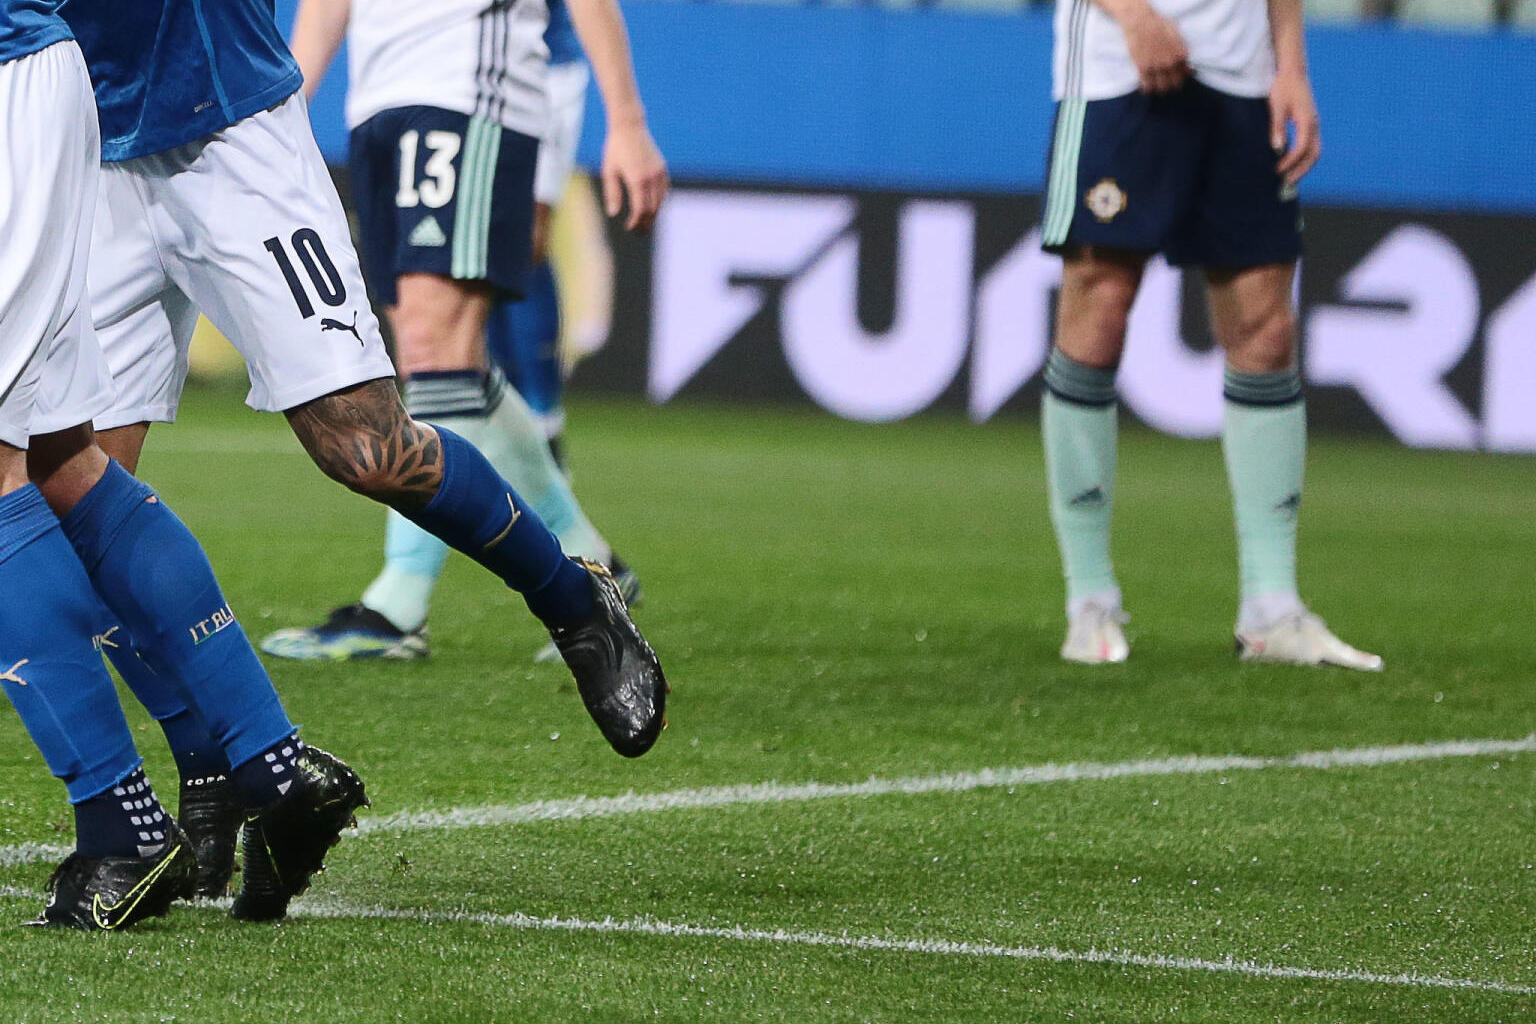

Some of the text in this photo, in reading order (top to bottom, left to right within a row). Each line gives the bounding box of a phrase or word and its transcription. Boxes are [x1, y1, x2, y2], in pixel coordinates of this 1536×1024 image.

[395, 129, 461, 209] 13
[263, 227, 347, 320] 10
[186, 774, 226, 787] COPA
